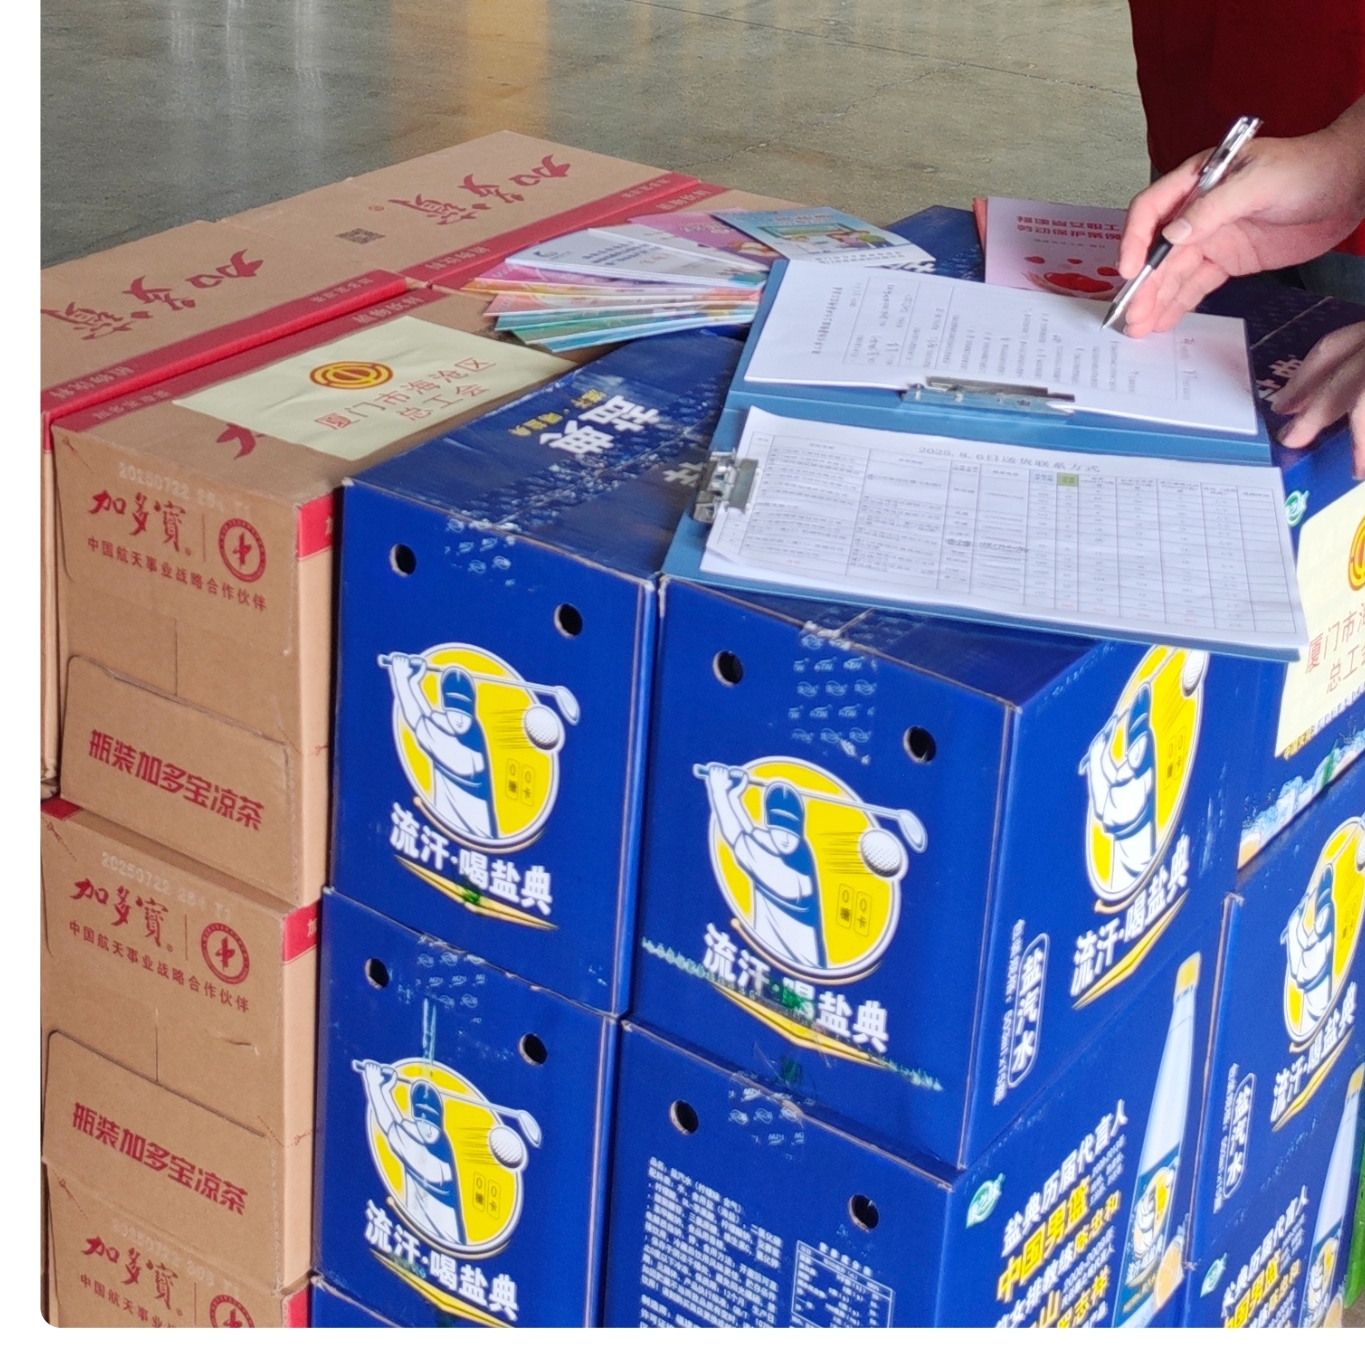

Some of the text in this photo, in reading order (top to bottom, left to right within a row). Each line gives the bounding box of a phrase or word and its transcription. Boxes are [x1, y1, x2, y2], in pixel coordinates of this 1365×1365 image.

[314, 356, 497, 430] 厦门市海沧区
[396, 383, 491, 422] 总工会
[87, 536, 267, 613] 中国航天事业战略合作伙伴
[87, 728, 266, 833] 瓶装加多宝凉茶
[68, 919, 251, 1015] 中国航天事业战略合作伙伴
[1011, 947, 1043, 1075] 盐汽水
[71, 1100, 250, 1217] 瓶装加多宝凉茶
[1001, 1098, 1129, 1258] 盐典历届代言人
[1226, 1084, 1251, 1187] 盐汽水
[996, 1174, 1092, 1304] 中国男篮
